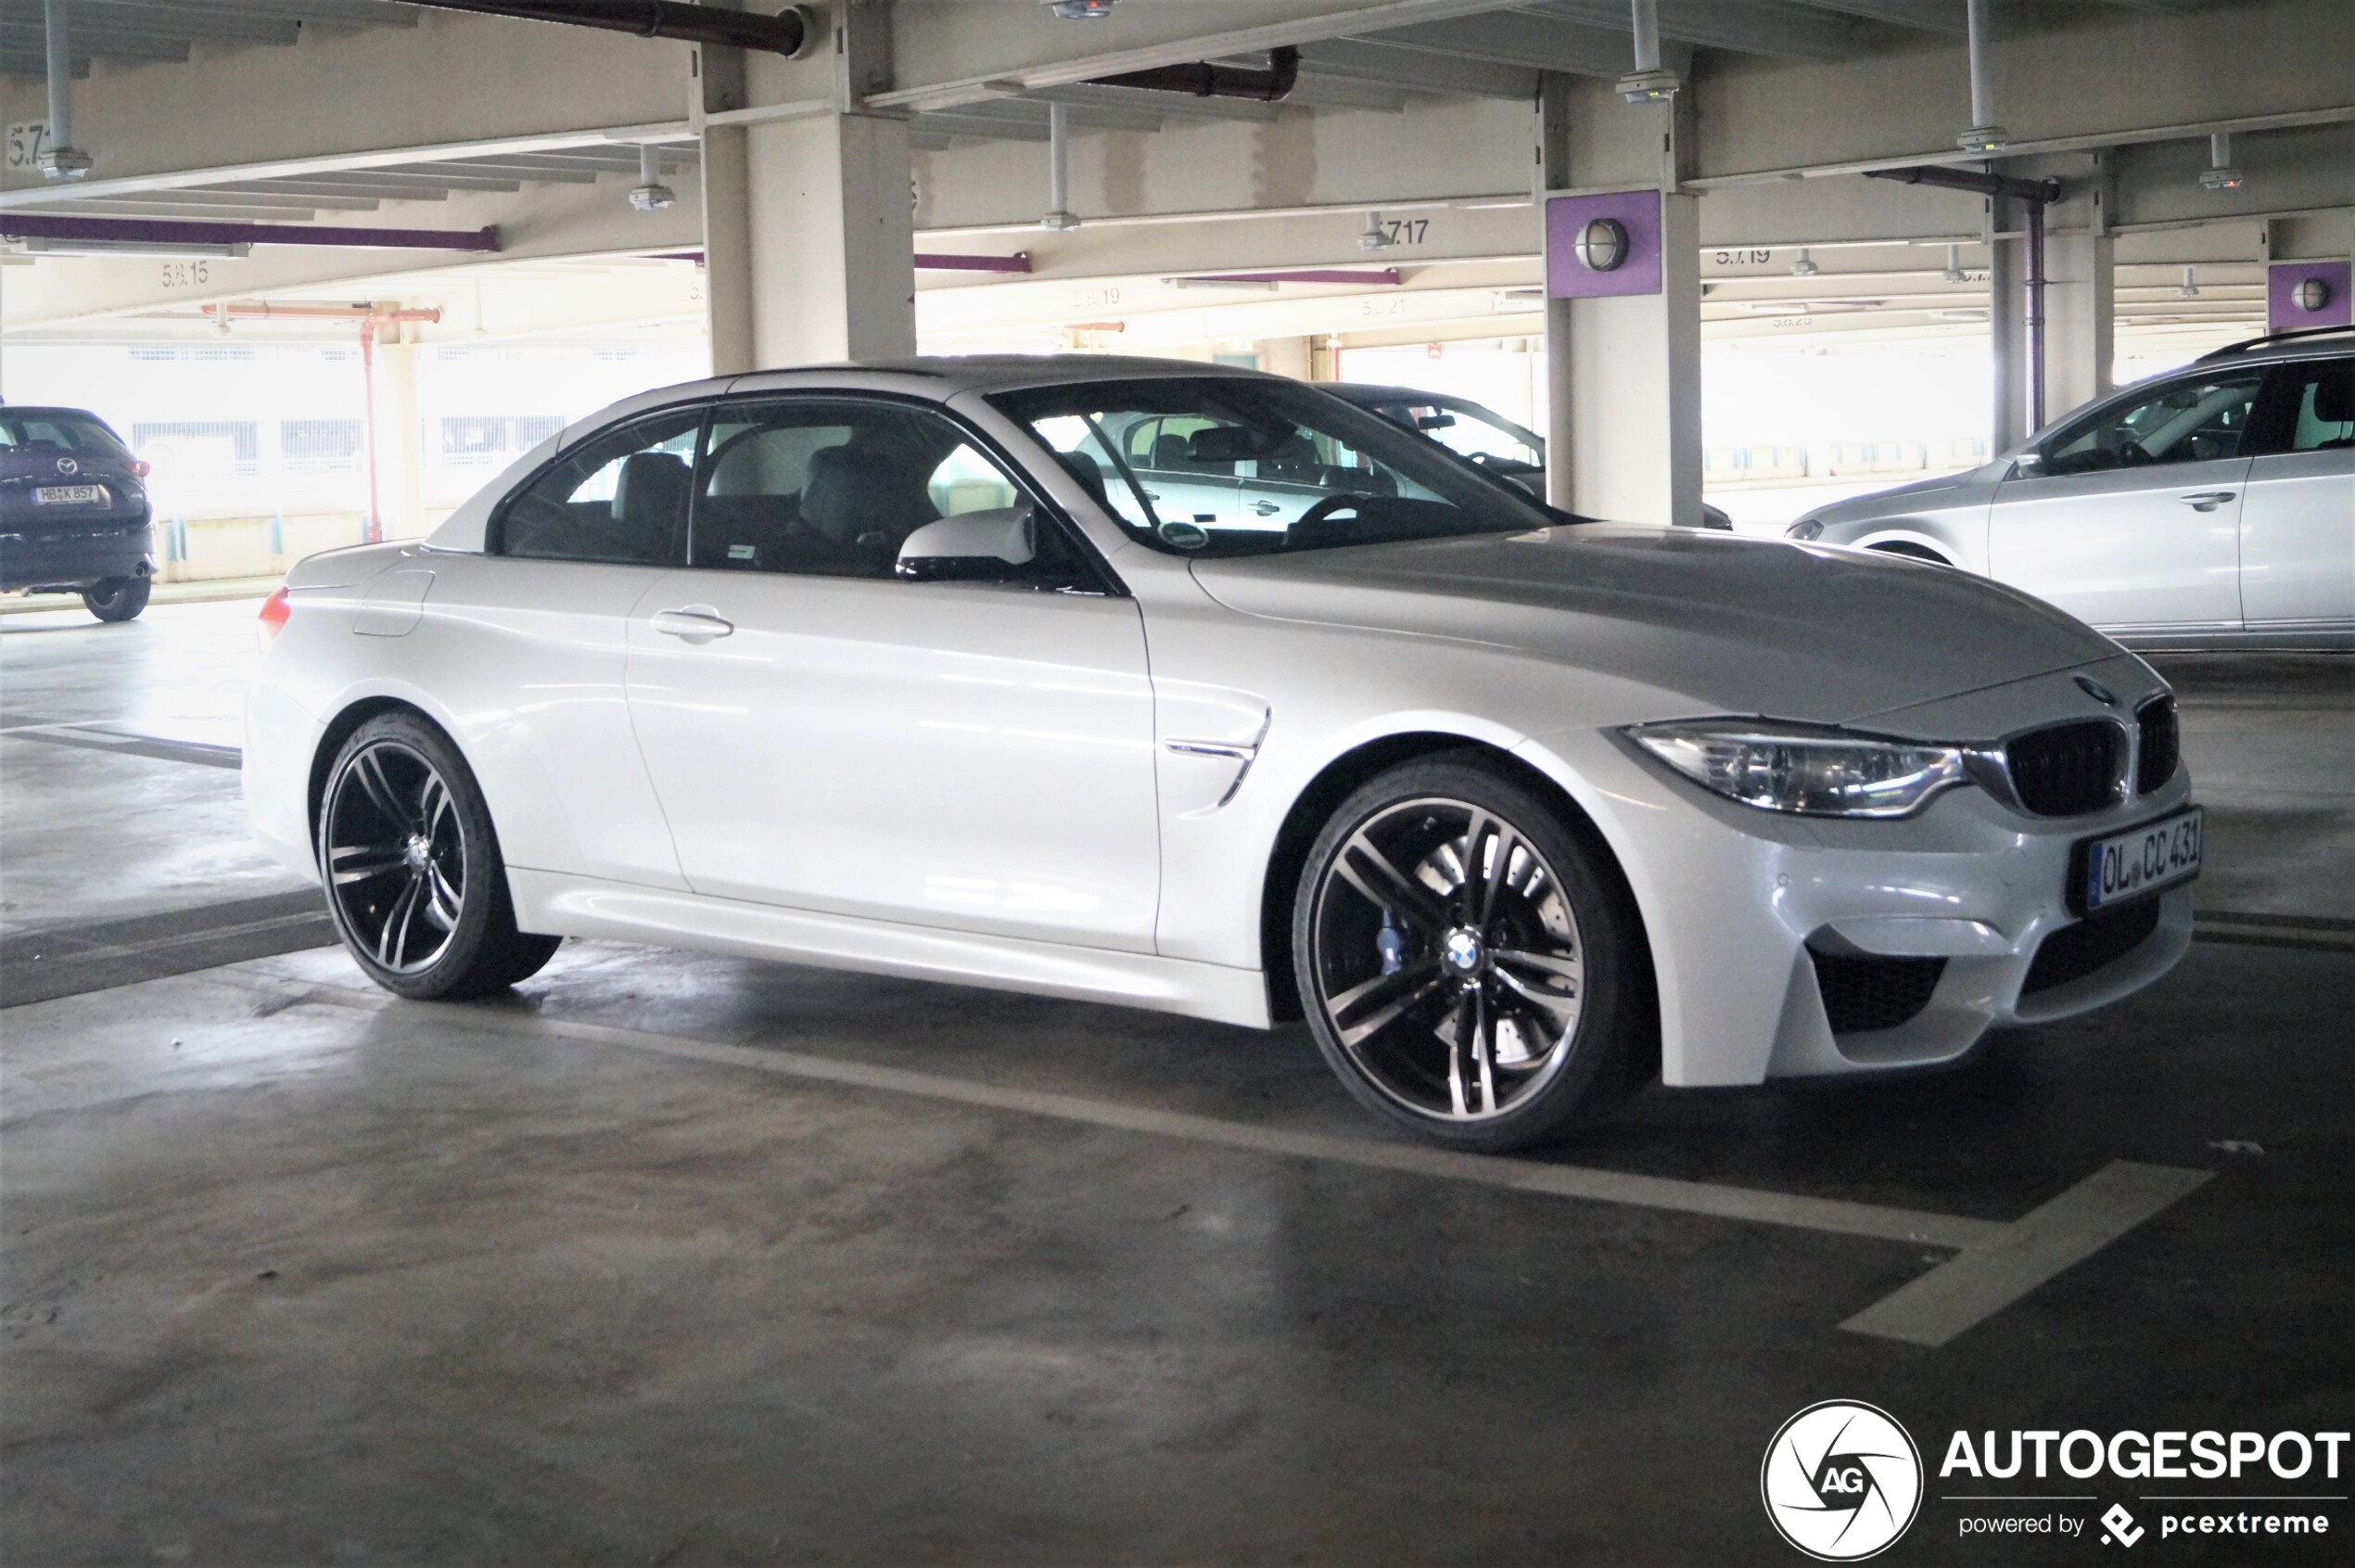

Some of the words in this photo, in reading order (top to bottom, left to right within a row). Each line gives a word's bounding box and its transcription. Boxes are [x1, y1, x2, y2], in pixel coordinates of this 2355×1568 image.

[9, 124, 51, 167] 5.7
[73, 487, 94, 499] 857
[2103, 843, 2130, 894] OL
[2144, 830, 2167, 880] CC
[2170, 819, 2198, 868] 431
